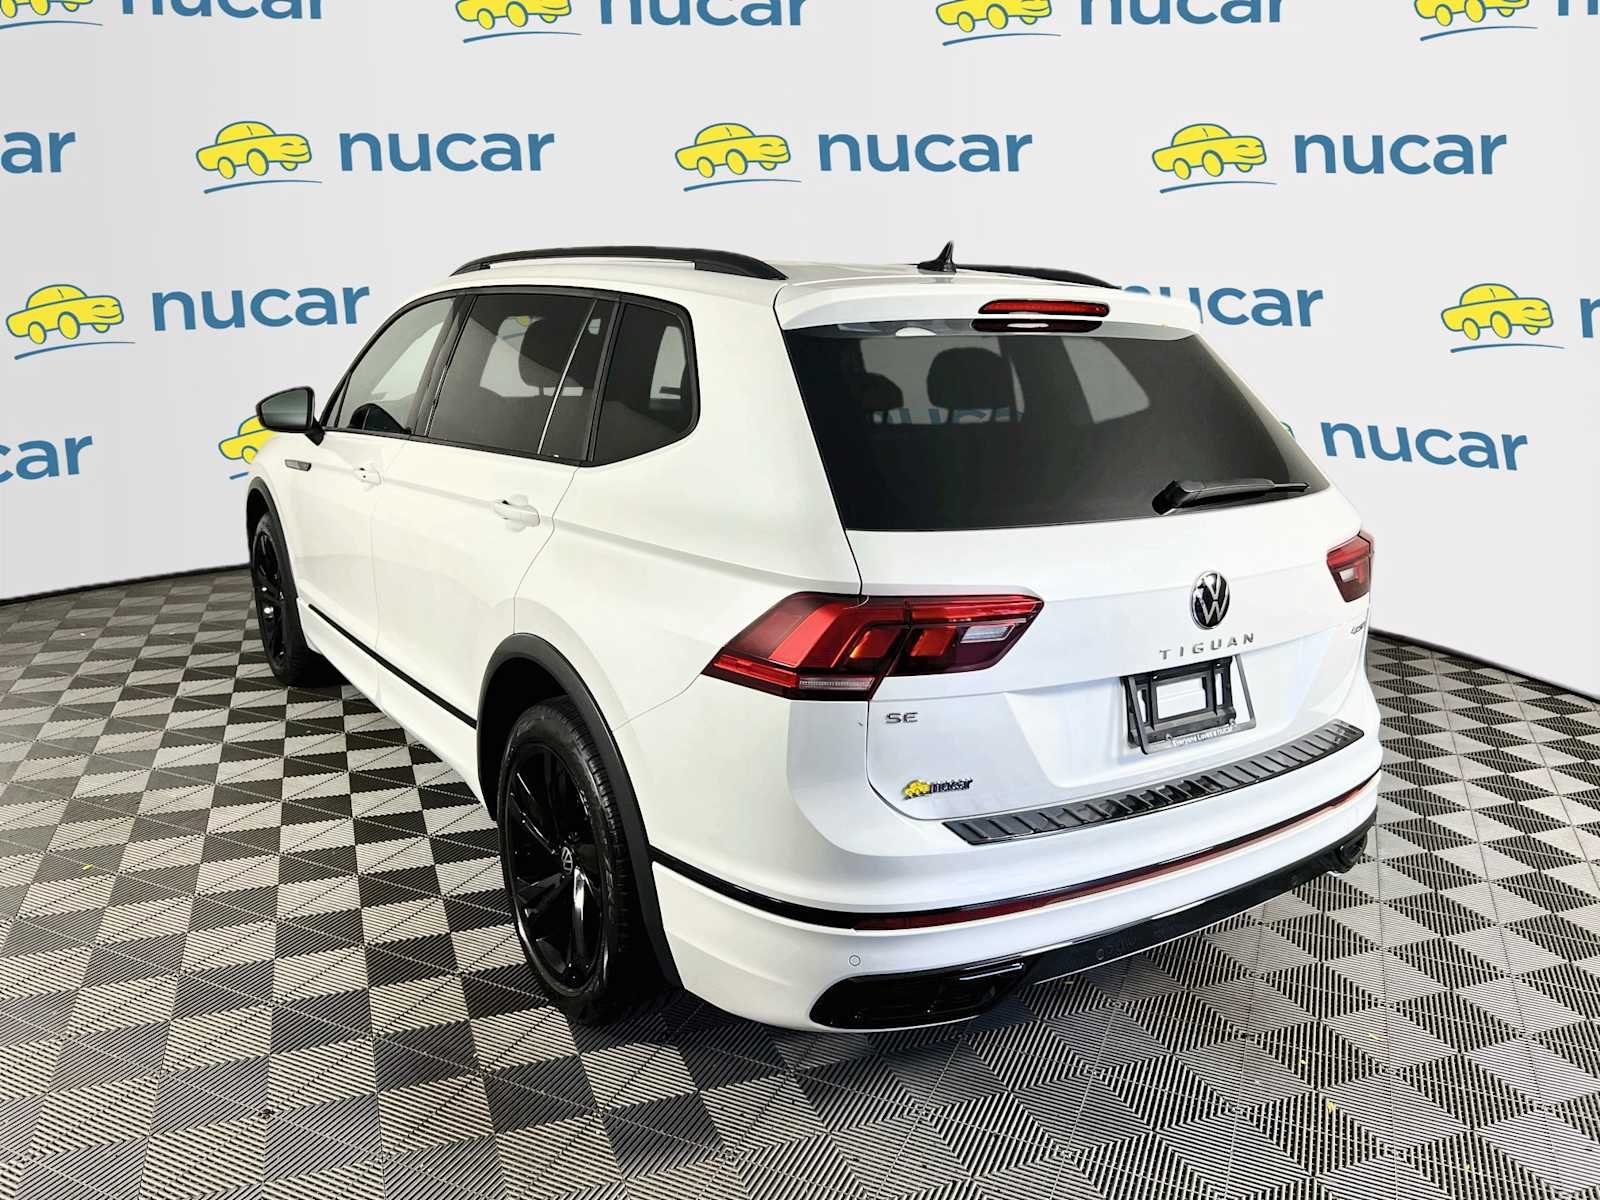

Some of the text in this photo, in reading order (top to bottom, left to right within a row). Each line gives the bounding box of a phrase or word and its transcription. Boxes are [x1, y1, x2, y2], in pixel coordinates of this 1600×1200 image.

[339, 132, 555, 173] nucar
[818, 133, 1033, 174] nucar
[1294, 133, 1507, 175] nucar
[152, 287, 370, 331] nucar
[1122, 285, 1324, 327] car
[1320, 421, 1529, 471] nucar
[1159, 632, 1254, 660] TIGUAN
[885, 711, 919, 724] SE
